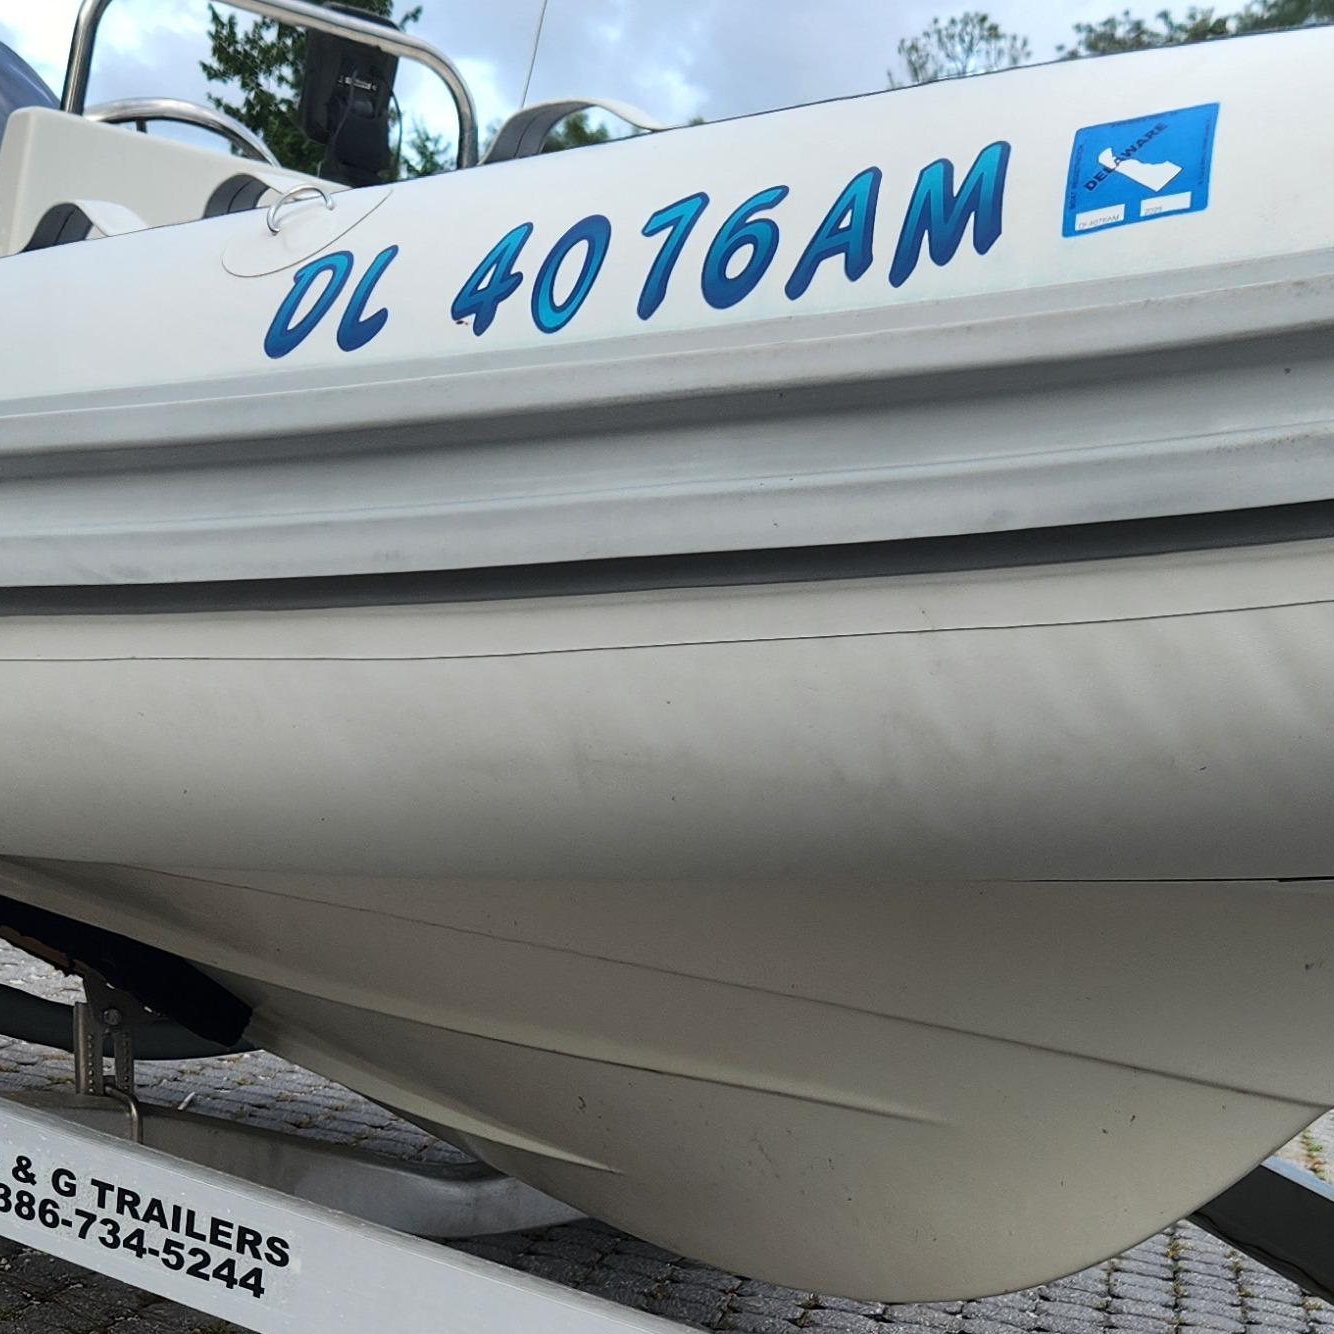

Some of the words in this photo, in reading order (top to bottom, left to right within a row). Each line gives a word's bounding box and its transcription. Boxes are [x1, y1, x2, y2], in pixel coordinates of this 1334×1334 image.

[1083, 122, 1168, 192] DELAWARE
[263, 244, 399, 359] DL
[11, 1155, 37, 1186] &
[51, 1168, 77, 1198] G
[91, 1178, 291, 1268] TRAILERS
